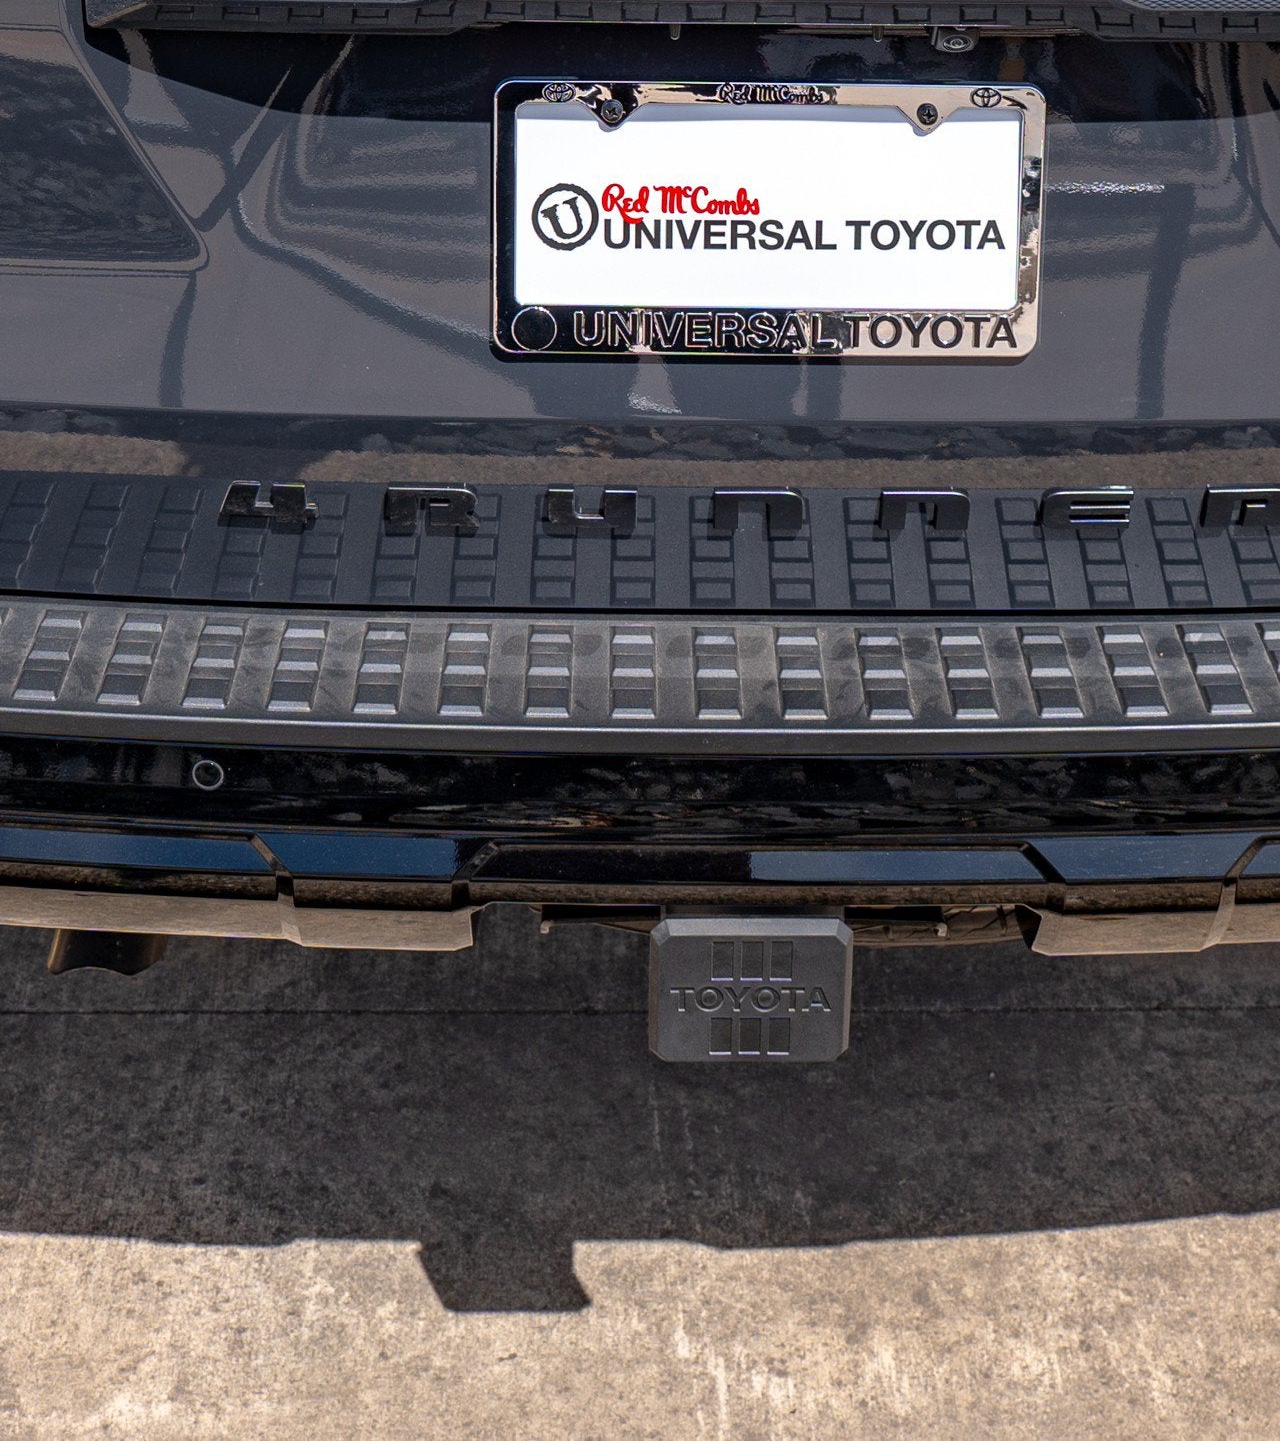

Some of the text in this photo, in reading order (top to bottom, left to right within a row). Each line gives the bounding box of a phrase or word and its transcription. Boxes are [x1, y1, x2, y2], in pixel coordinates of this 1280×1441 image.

[601, 182, 761, 224] Red McCombs
[604, 218, 1006, 251] UNIVERSAL TOYOTA
[573, 310, 1018, 350] UNIVERSAL TOYOTA
[669, 986, 833, 1013] TOYOTA
